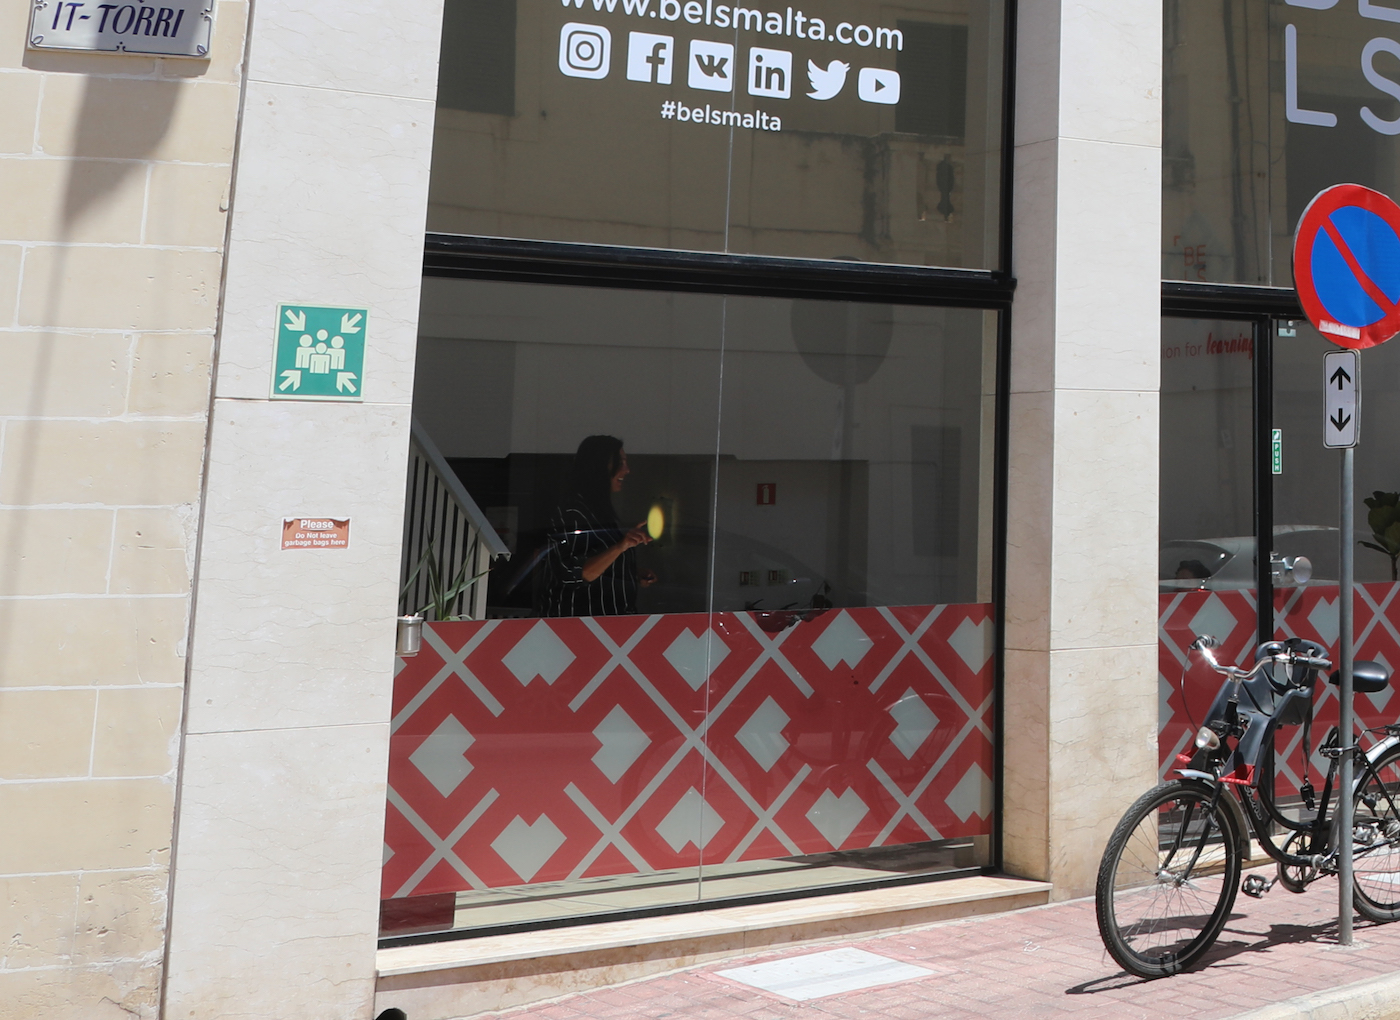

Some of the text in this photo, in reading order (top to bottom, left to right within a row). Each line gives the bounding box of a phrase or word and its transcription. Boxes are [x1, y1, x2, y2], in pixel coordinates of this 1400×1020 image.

[660, 100, 782, 132] #belsmalta
[1185, 342, 1202, 357] for
[1206, 332, 1253, 360] learning
[300, 519, 334, 529] Please
